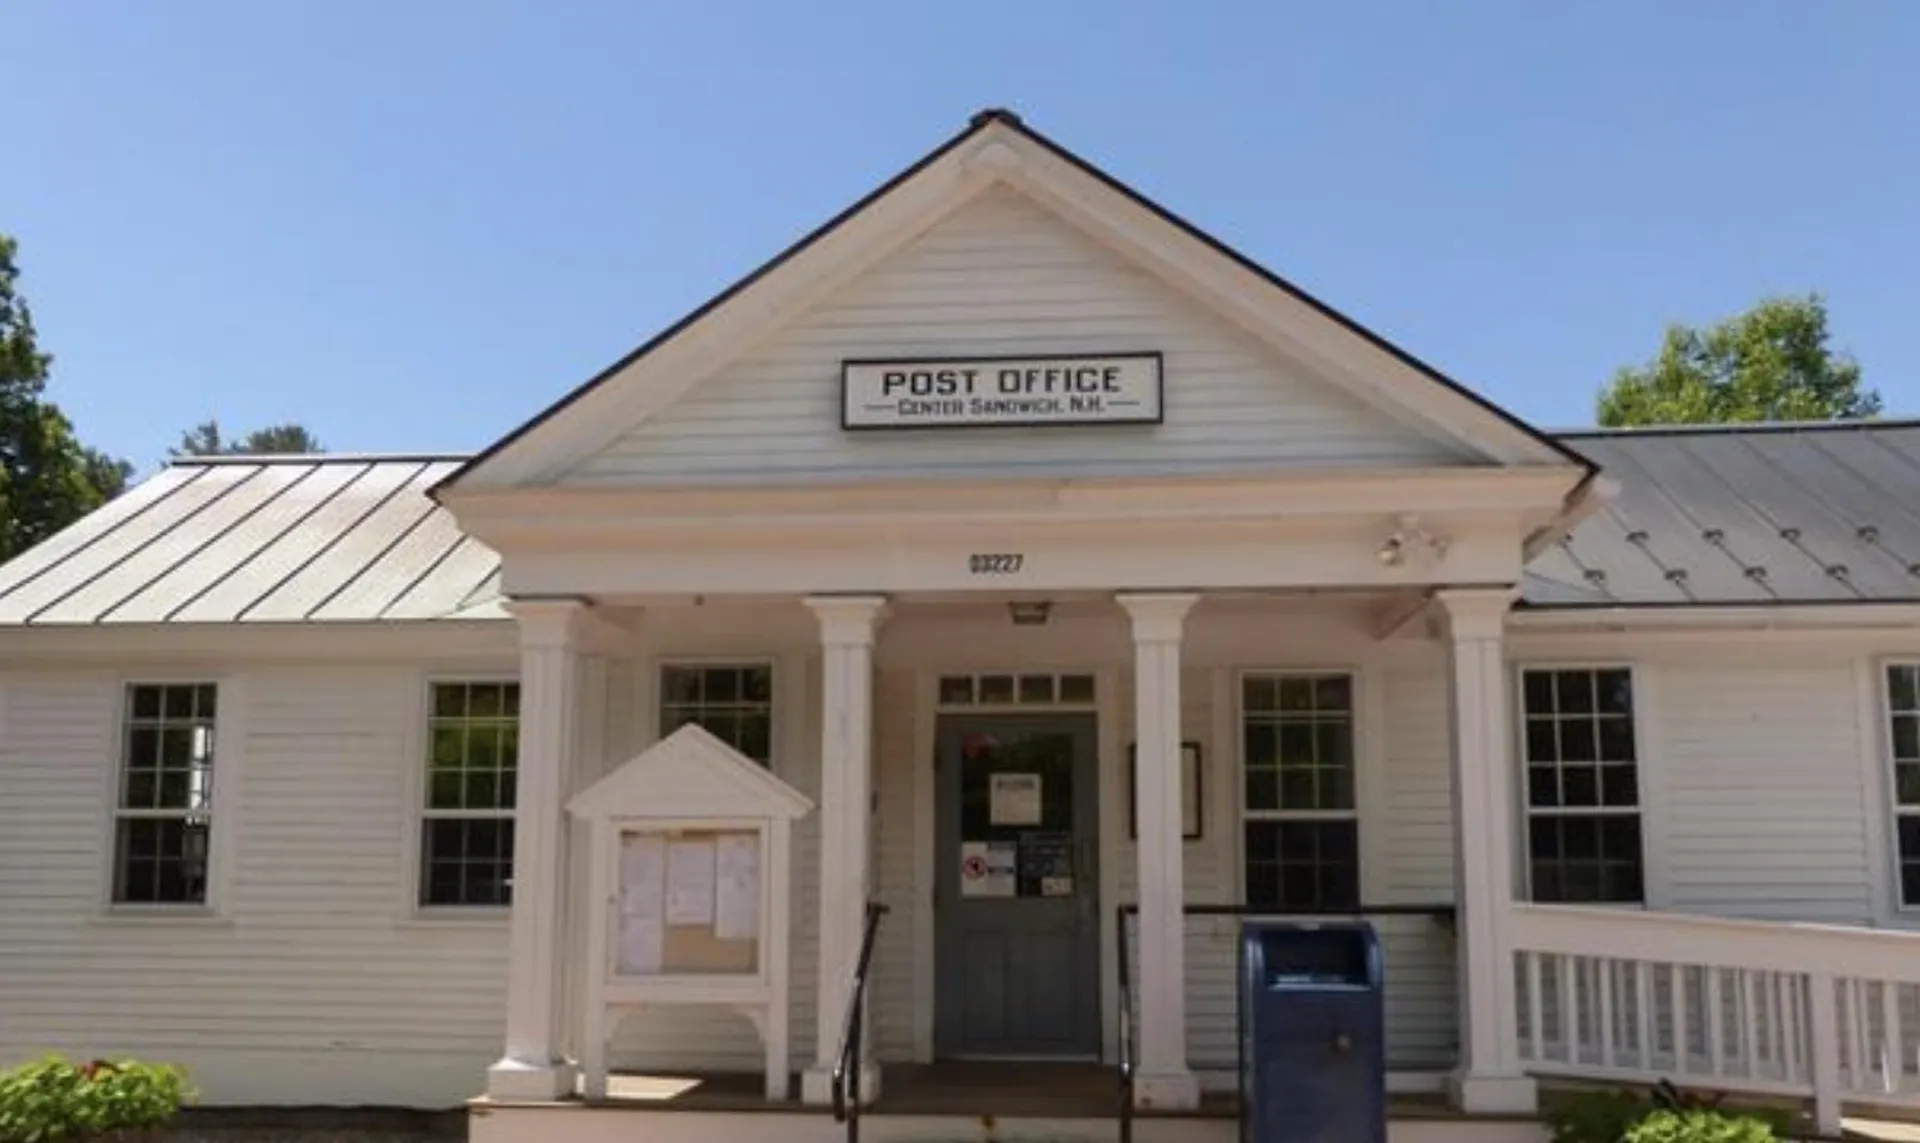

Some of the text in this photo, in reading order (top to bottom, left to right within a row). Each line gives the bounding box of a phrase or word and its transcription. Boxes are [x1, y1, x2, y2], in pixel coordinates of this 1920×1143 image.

[883, 367, 1121, 395] POST OFFICE
[969, 554, 1023, 573] 03227
